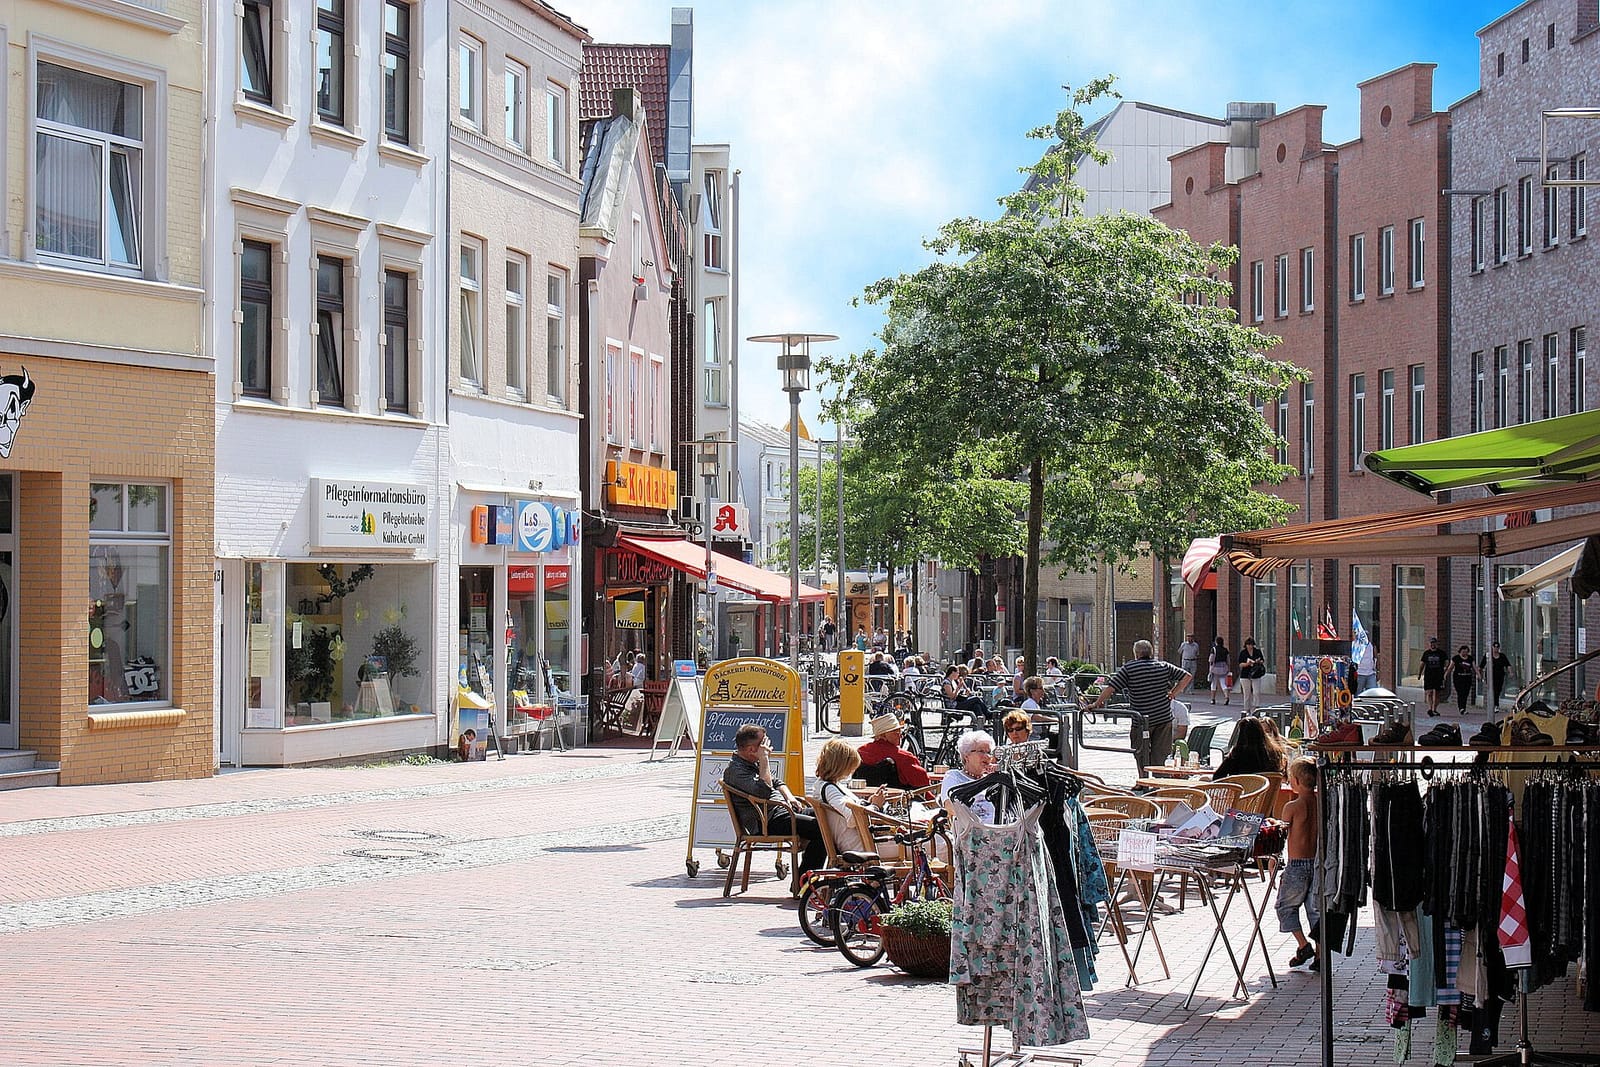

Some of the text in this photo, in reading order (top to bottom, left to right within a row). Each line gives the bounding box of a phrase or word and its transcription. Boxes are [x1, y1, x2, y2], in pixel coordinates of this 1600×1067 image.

[629, 467, 667, 505] Kodak
[325, 483, 426, 507] Pflegeinformationsbüro
[382, 511, 425, 528] Pflegebetriebe
[408, 533, 425, 544] GmbH
[617, 552, 638, 581] FOTO
[616, 619, 645, 628] Nikon
[732, 683, 786, 699] Frähmcke
